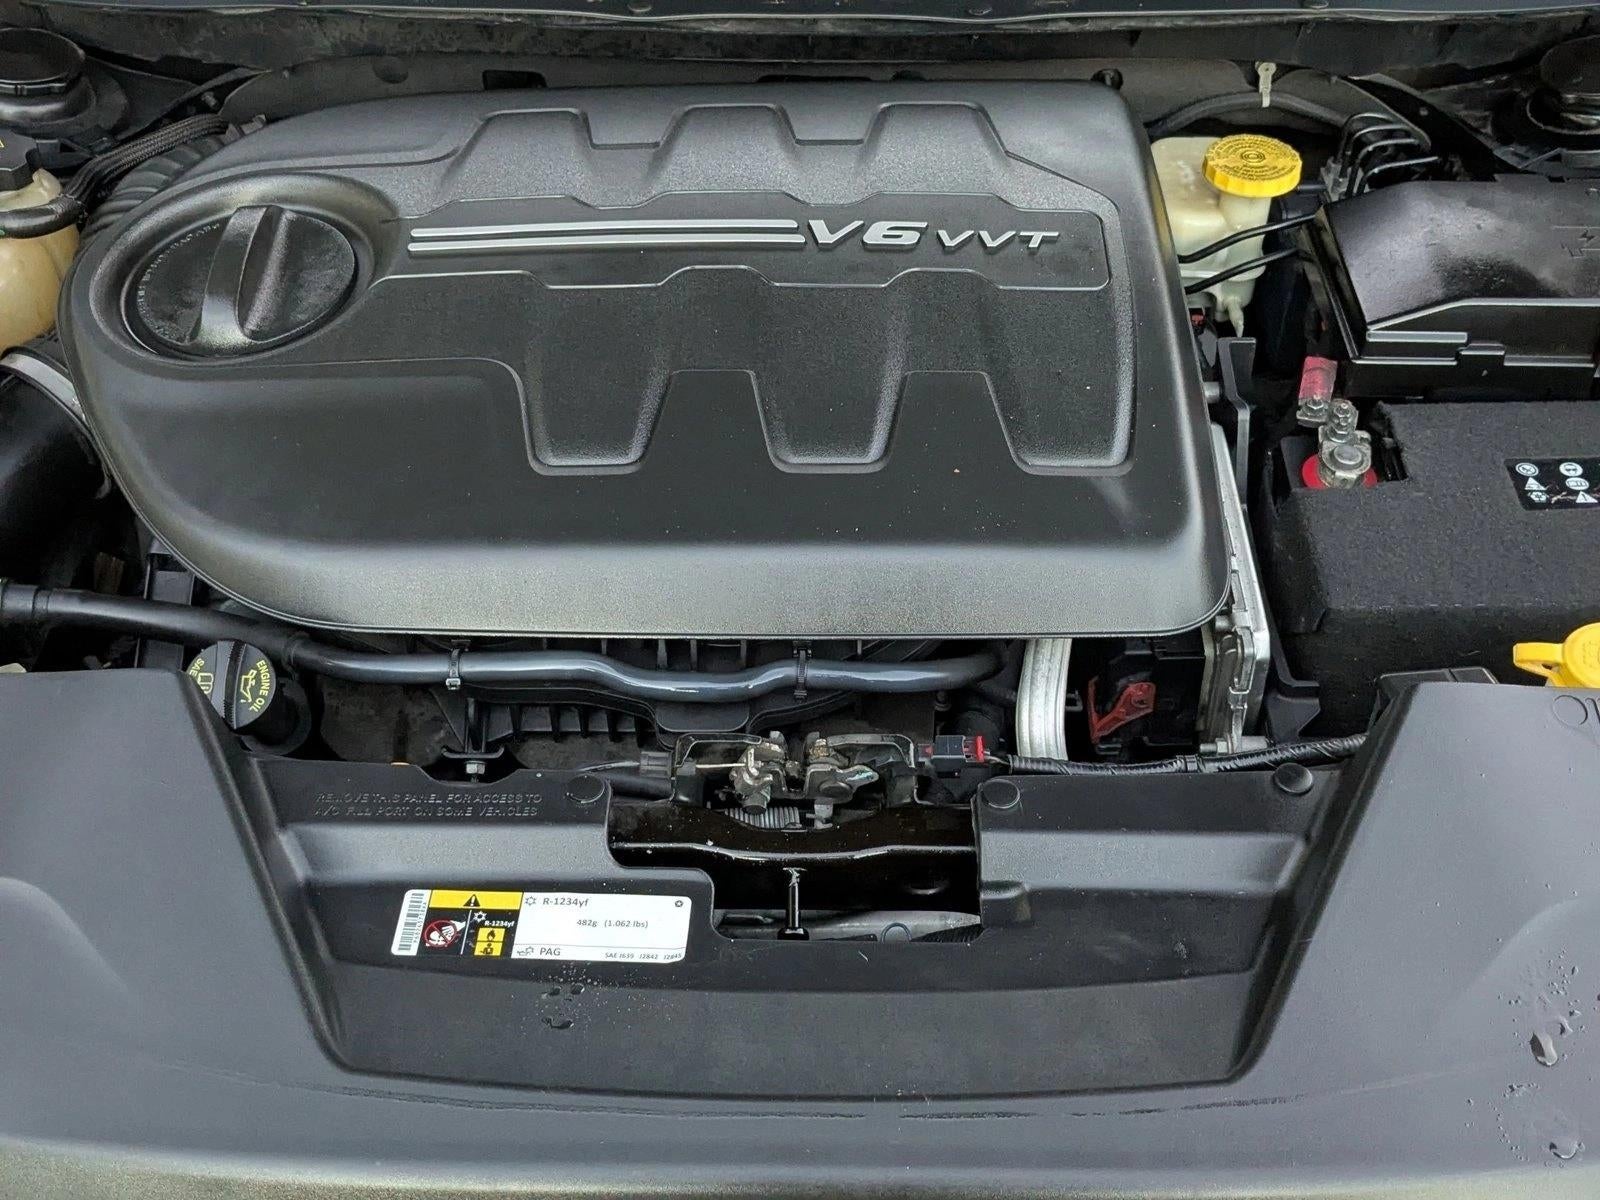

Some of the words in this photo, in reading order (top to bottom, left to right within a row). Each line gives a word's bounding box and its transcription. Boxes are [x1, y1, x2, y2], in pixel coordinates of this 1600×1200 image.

[808, 219, 928, 249] V6
[936, 229, 1060, 251] VVT
[189, 658, 205, 677] SAE
[256, 660, 271, 696] ENGINE
[249, 697, 265, 713] OIL
[403, 793, 442, 803] PANEL
[446, 793, 472, 803] FOR
[473, 793, 523, 803] ACCESS
[525, 794, 542, 803] TO
[436, 806, 473, 816] SOME
[479, 806, 538, 816] VEHICLES
[542, 897, 589, 908] R-1234yf
[484, 920, 515, 928] R-1234yf
[576, 919, 598, 928] 482g
[604, 919, 631, 928] (1.062
[539, 947, 561, 957] PAG
